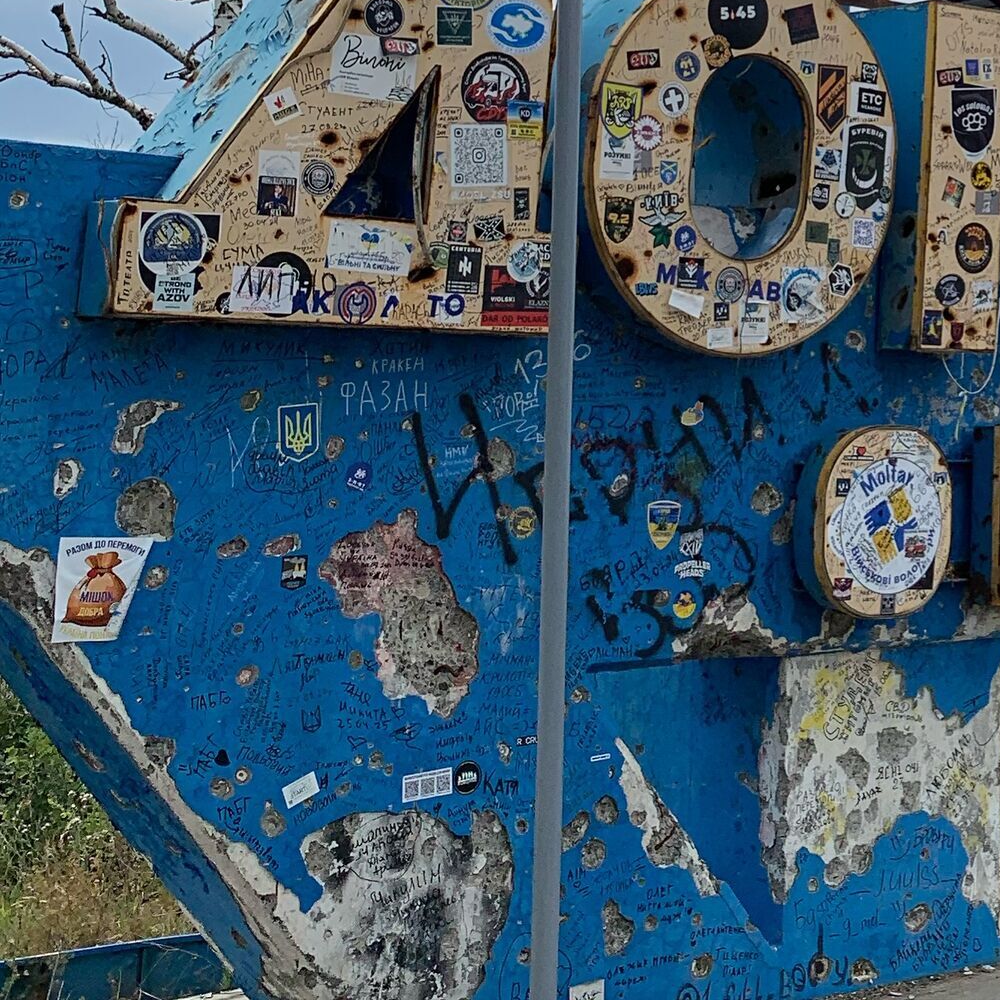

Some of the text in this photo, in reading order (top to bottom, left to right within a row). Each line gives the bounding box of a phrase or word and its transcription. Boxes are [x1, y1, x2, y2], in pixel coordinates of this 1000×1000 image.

[861, 92, 883, 107] ETC
[645, 191, 680, 211] КИЇВ
[608, 212, 629, 224] 9.2
[451, 245, 482, 253] CENTURIA
[156, 294, 190, 302] AZOV
[482, 315, 498, 323] DAR
[517, 314, 548, 323] POLAKÓ
[371, 357, 424, 374] КРАКЕН
[340, 380, 427, 415] ФАЗАН
[65, 540, 146, 557] РАЗОМ ДО ПЕРЕМОГИ
[77, 607, 104, 617] ДОБРА
